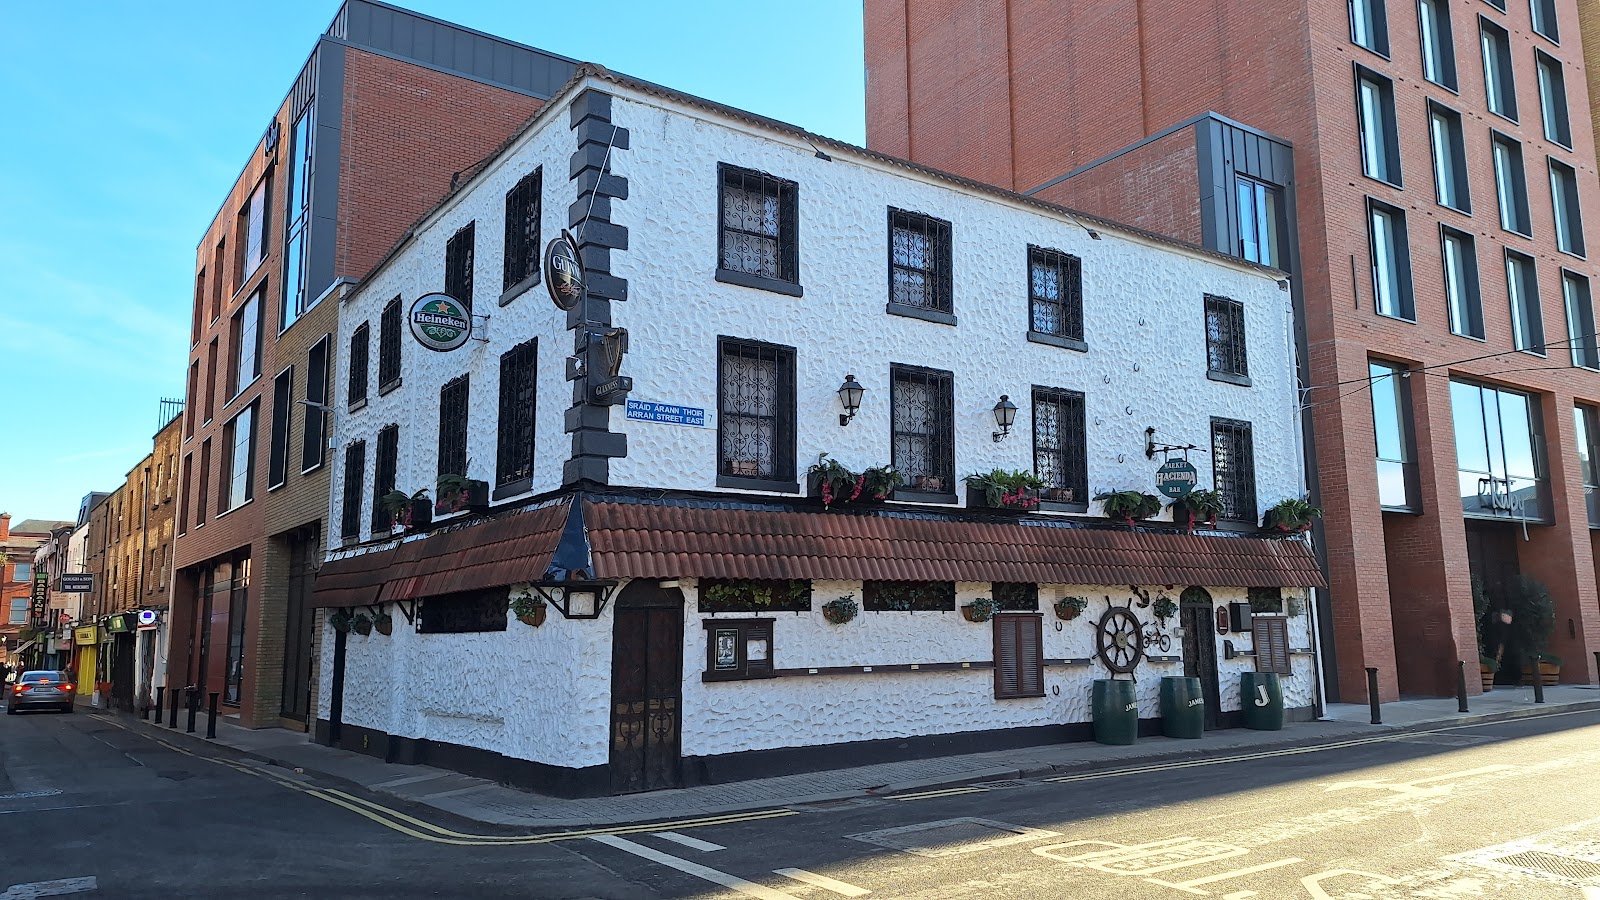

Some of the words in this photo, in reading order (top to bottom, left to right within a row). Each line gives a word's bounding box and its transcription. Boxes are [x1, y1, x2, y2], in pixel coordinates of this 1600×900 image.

[416, 313, 467, 329] Heineken
[628, 401, 651, 411] SRÁID
[654, 403, 680, 414] ÁRANN
[682, 408, 703, 417] THOIR
[627, 410, 654, 420] ARRAN
[656, 413, 683, 422] STREET
[686, 417, 704, 425] EAST
[1156, 471, 1196, 486] HACIENDA
[1254, 685, 1270, 707] J
